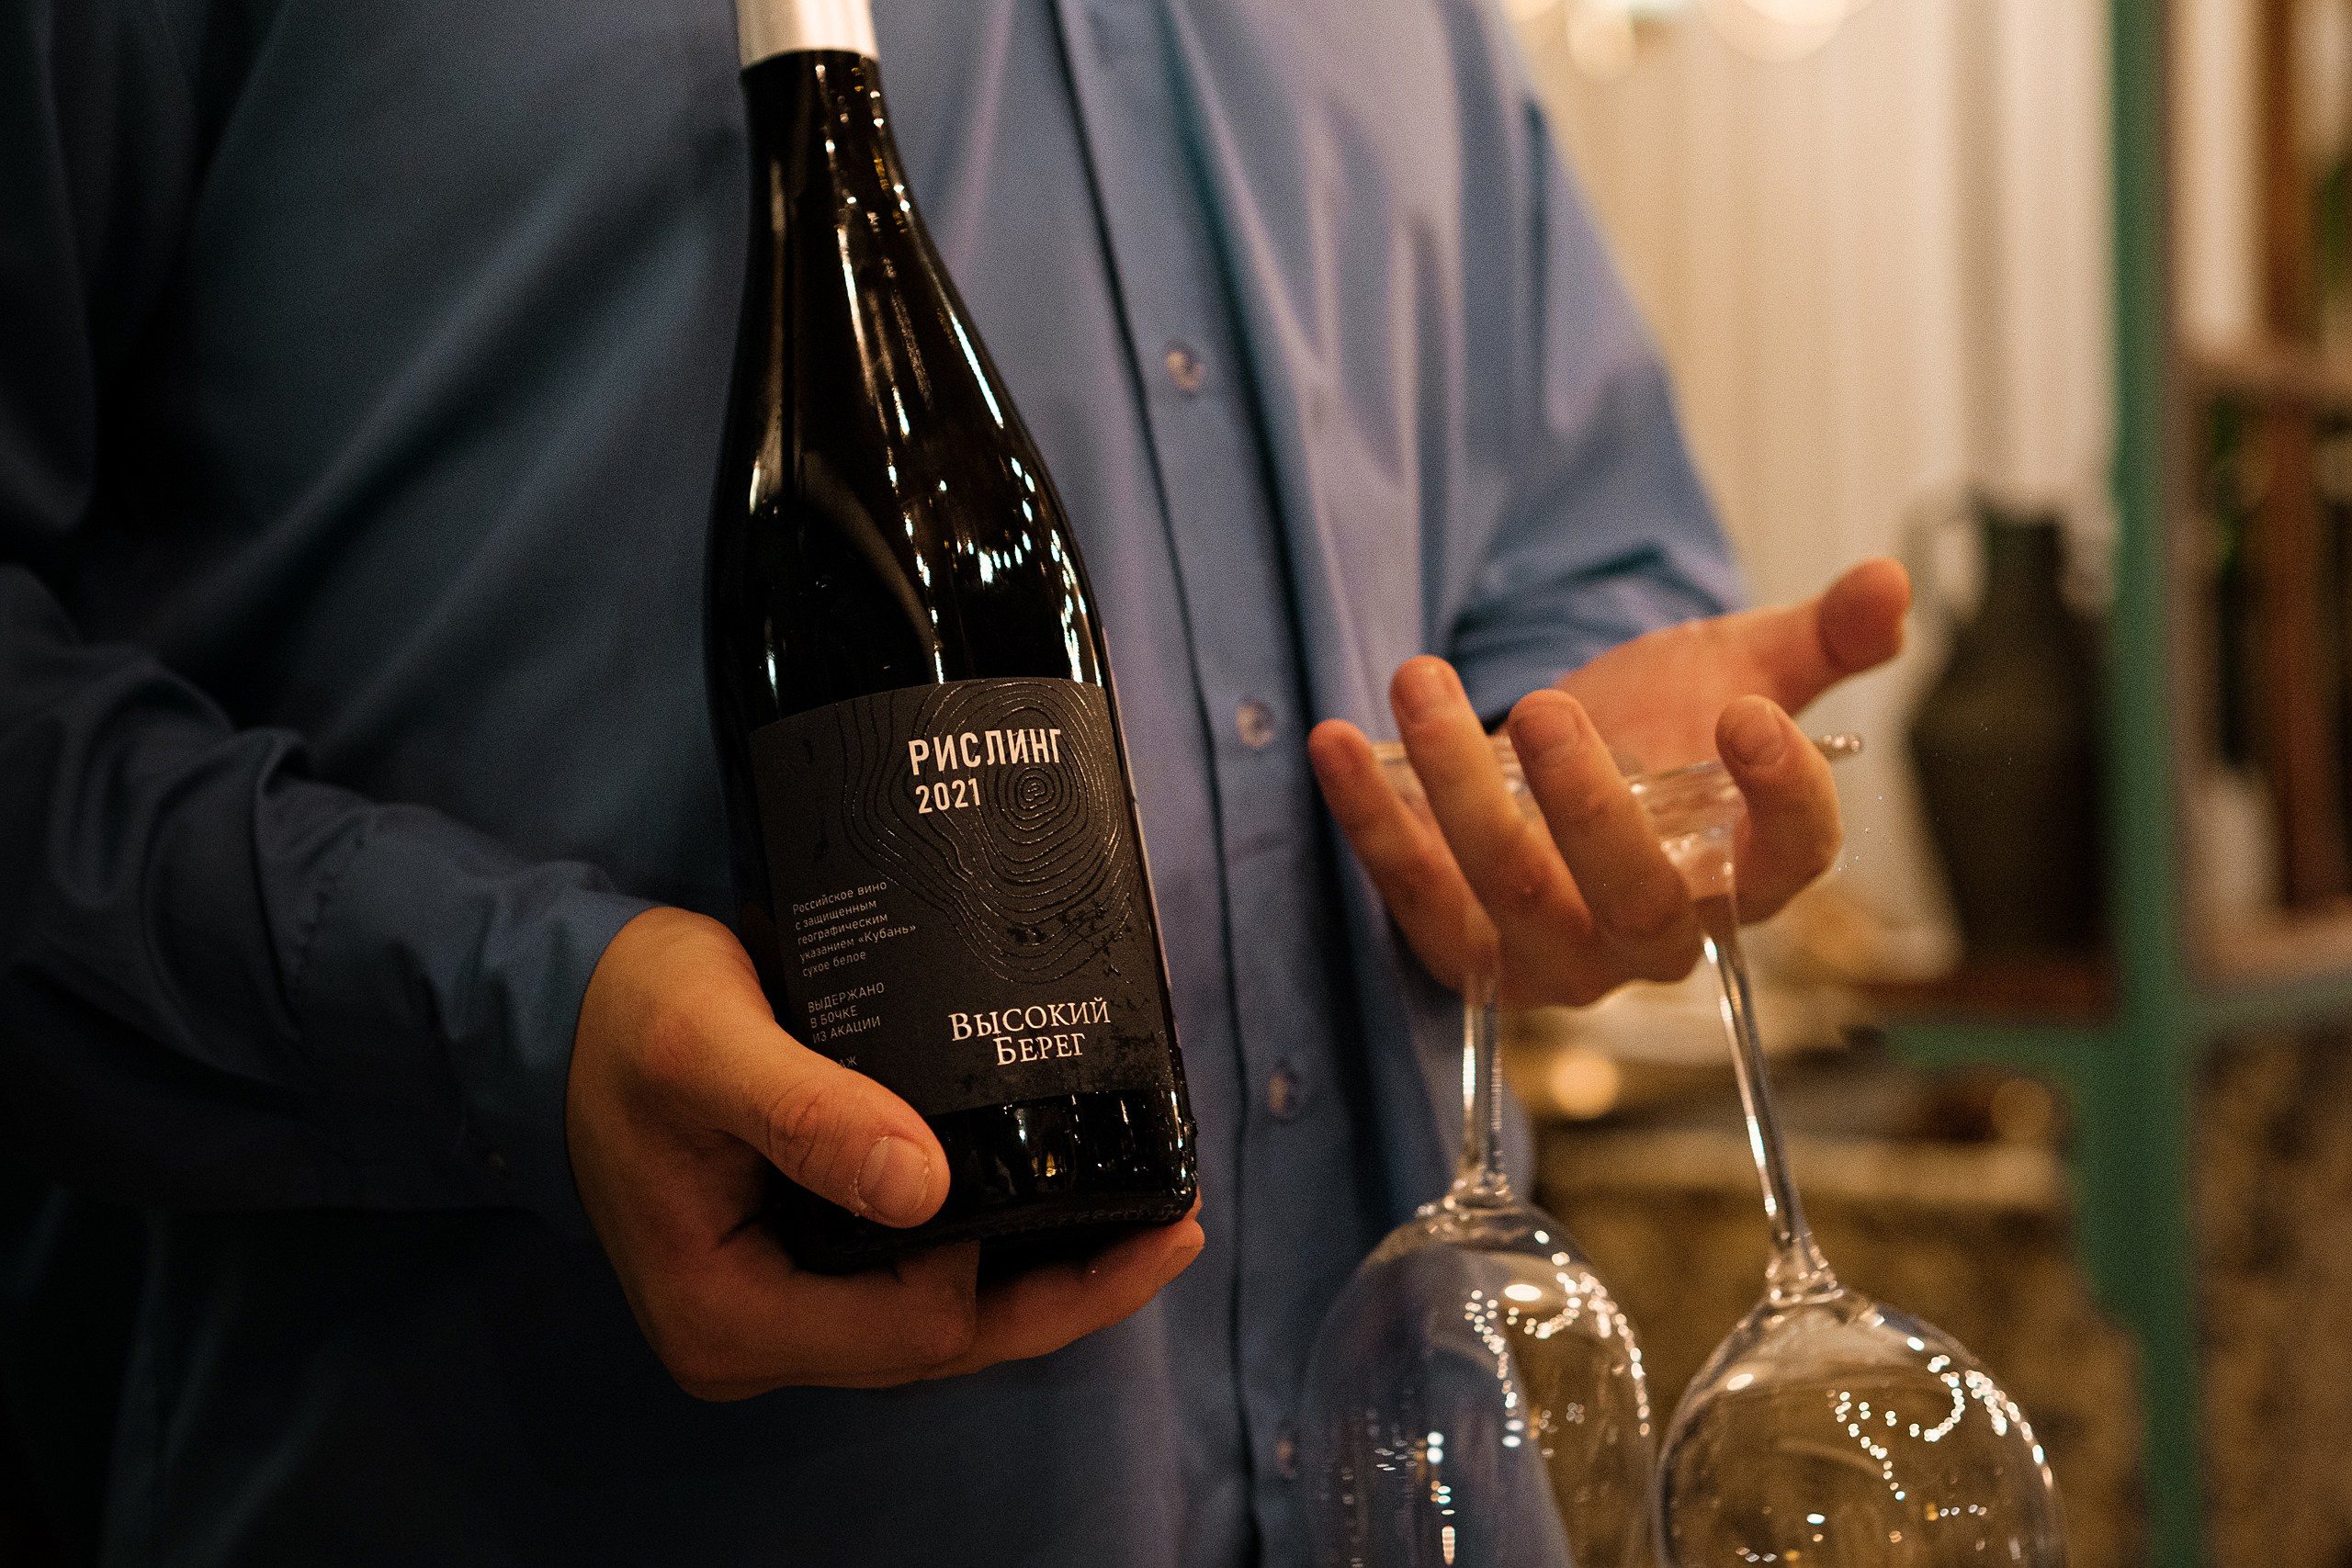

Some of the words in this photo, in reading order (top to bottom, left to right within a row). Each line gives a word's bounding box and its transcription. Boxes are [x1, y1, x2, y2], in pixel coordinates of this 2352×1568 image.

[908, 728, 1061, 776] РИСЛИНГ
[915, 778, 981, 815] 2021
[793, 888, 854, 915] Российское
[857, 881, 888, 896] вино
[795, 921, 801, 931] с
[803, 898, 877, 928] защищенным
[797, 913, 888, 946] географическим
[799, 937, 854, 964] указанием
[858, 924, 917, 945] «Кубань»
[802, 960, 830, 977] сухое
[832, 949, 866, 967] белое
[808, 981, 885, 1013] ВЫДЕРЖАНО
[809, 1016, 817, 1029] В
[820, 1005, 858, 1026] БОЧКЕ
[812, 1030, 827, 1044] ИЗ
[830, 1015, 881, 1038] АКАЦИИ
